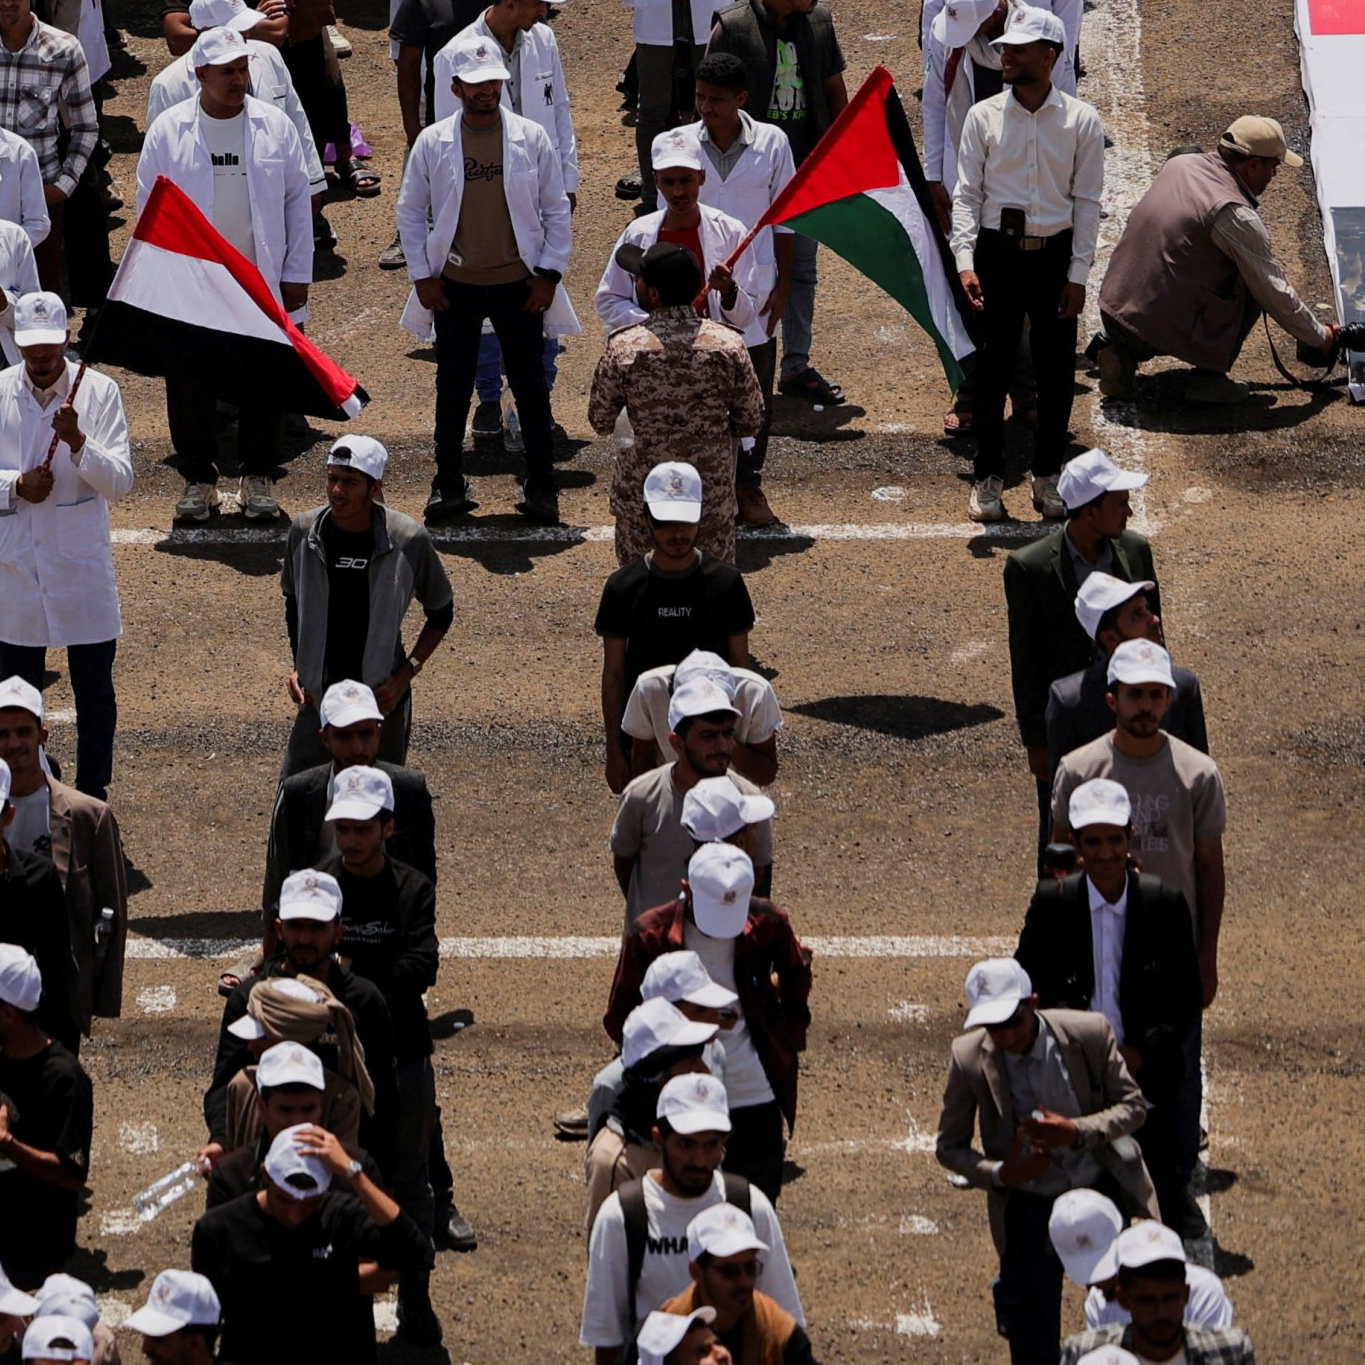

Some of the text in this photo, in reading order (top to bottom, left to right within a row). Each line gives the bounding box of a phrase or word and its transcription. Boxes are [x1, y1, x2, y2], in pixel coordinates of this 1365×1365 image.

[211, 153, 239, 166] hello
[335, 557, 368, 569] 30
[658, 607, 692, 617] REALITY
[647, 1236, 689, 1255] WHA
